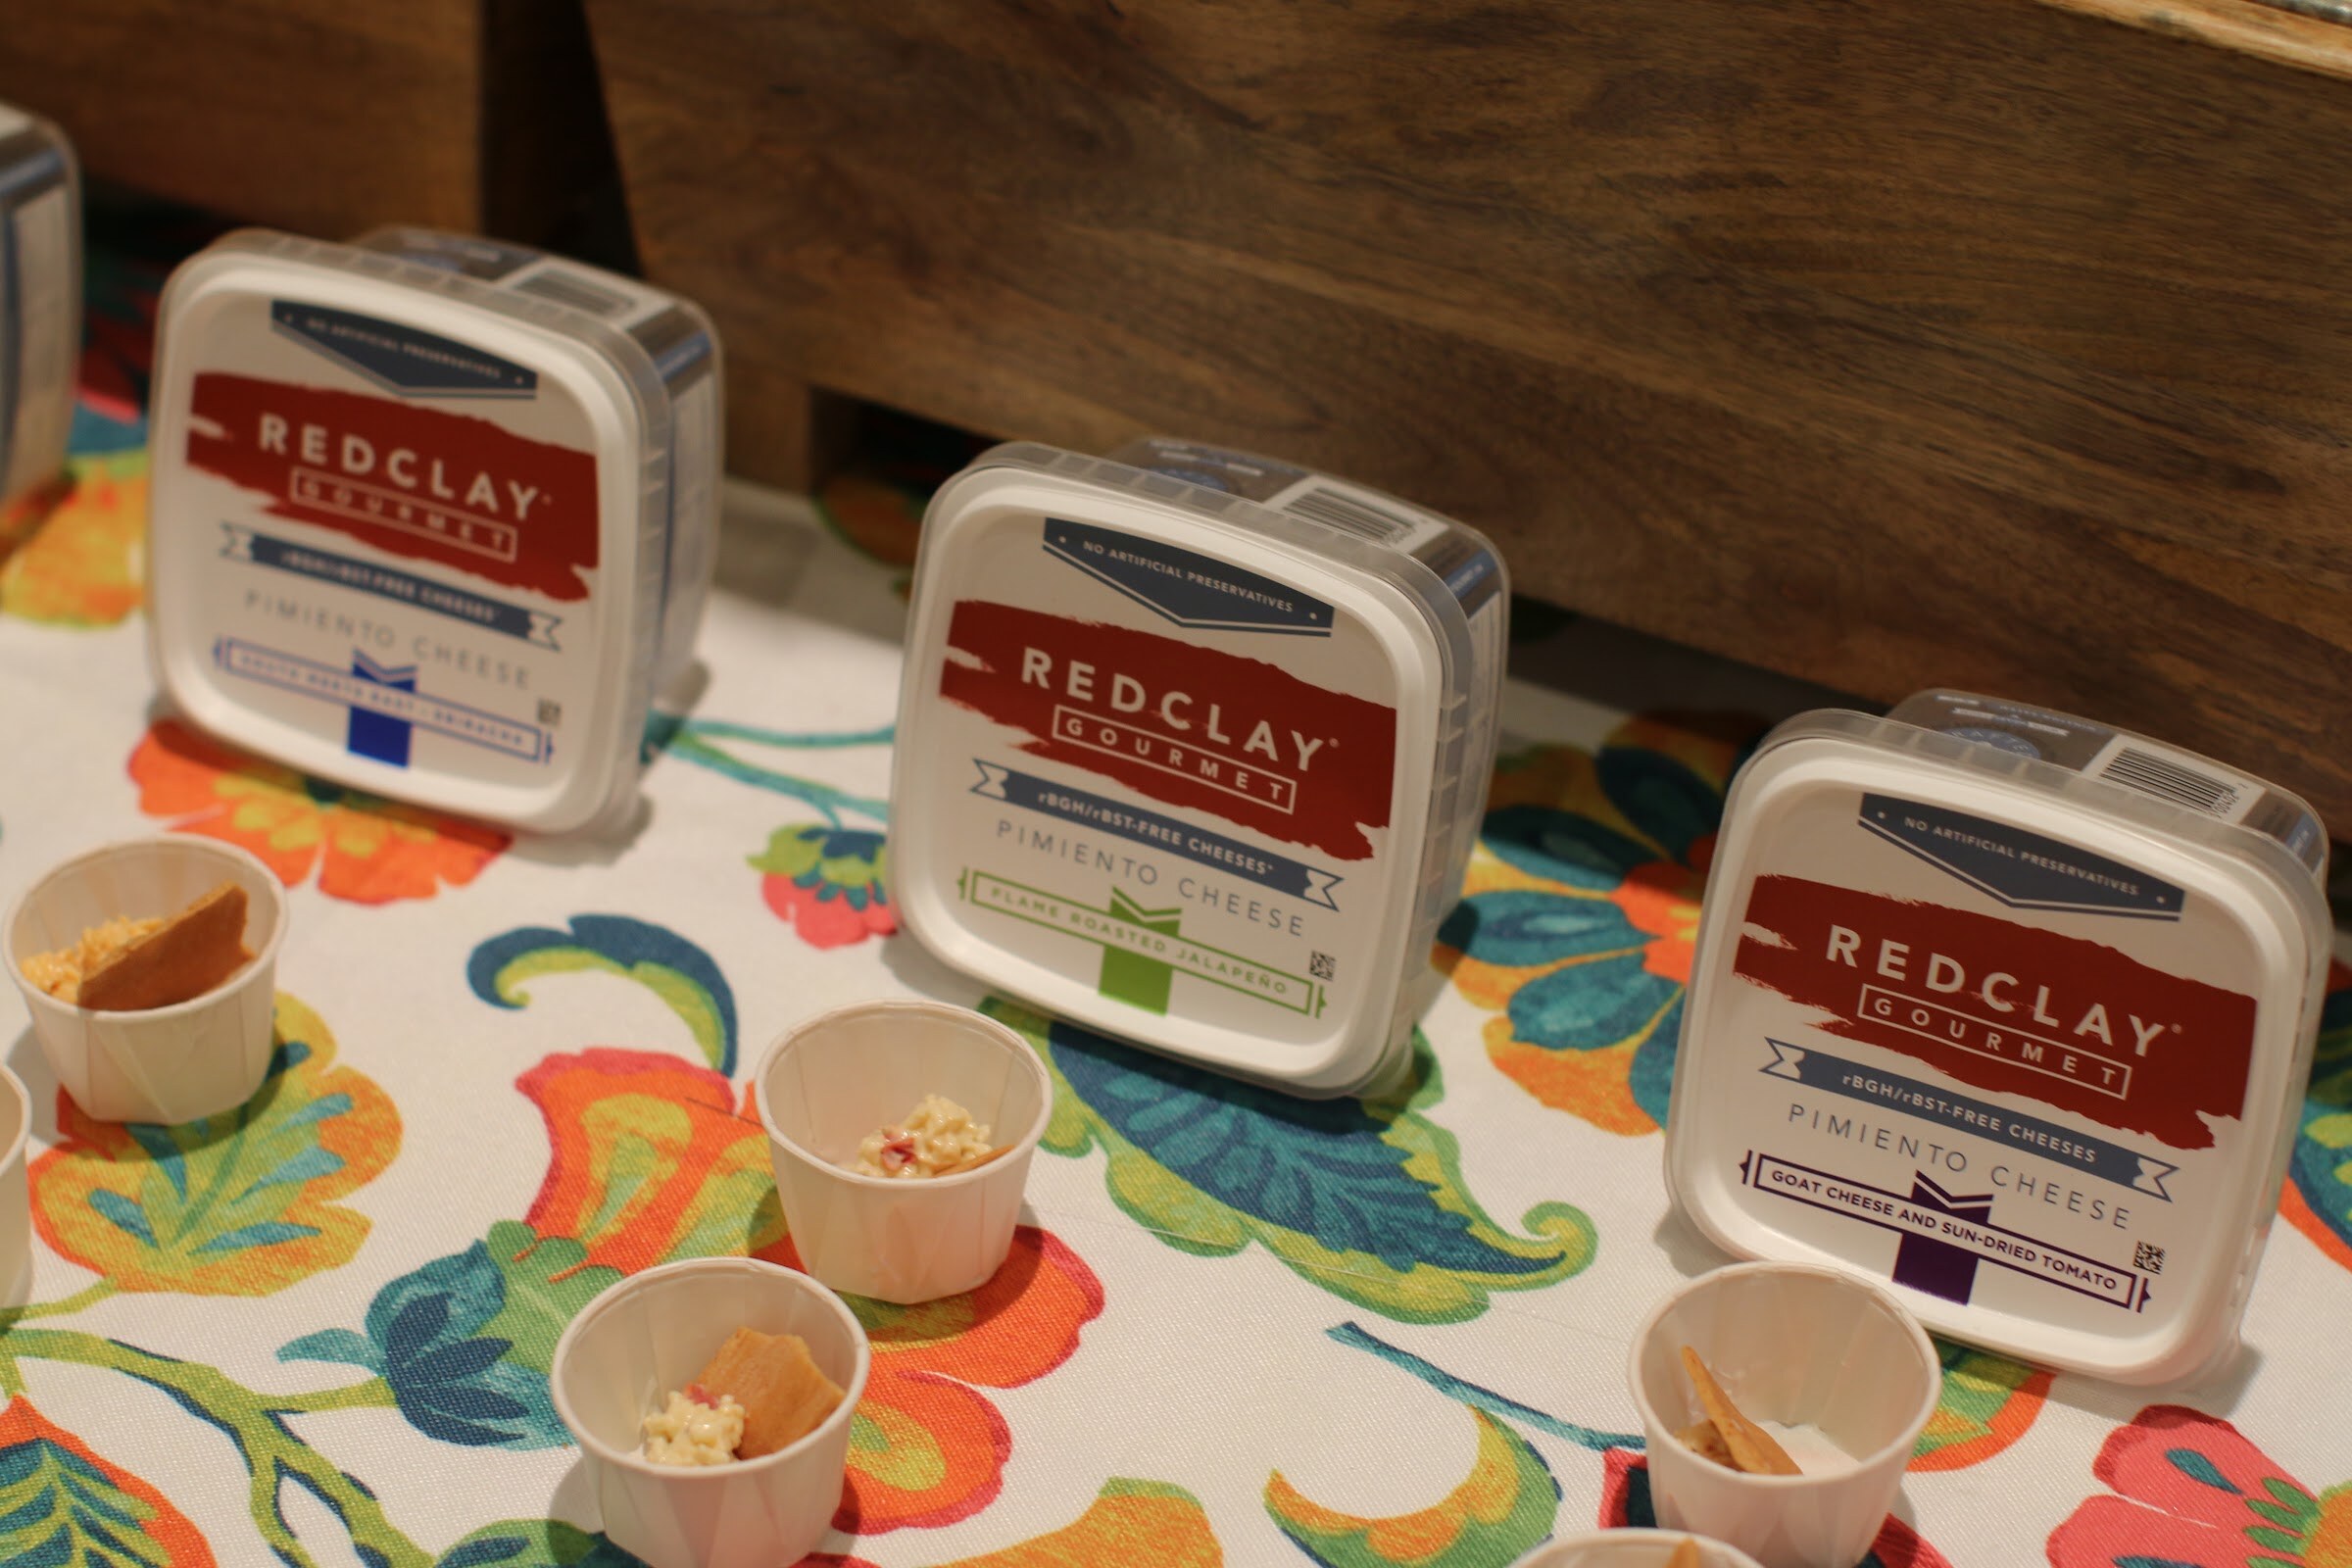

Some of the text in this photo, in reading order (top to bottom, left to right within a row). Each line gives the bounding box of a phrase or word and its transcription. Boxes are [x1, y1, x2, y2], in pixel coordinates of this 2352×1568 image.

[259, 412, 538, 520] REDCLAY
[1082, 539, 1294, 612] NO ARTIFICIAL PRESERVATIVES
[245, 589, 530, 690] PIMIENTO CHEESE
[1066, 717, 1283, 801] GOURMET
[997, 818, 1304, 937] PIMIENTO CHEESE
[1903, 815, 2141, 897] NO ARTIFICIAL PRESERVATIVES
[991, 886, 1060, 918] FLAME
[1069, 911, 1168, 954] ROASTED
[1873, 997, 2117, 1085] GOURMET
[1841, 1074, 2098, 1164] rBGH/rBST-FREE CHEESES
[1787, 1102, 2132, 1231] PIMIENTO CHEESE
[1771, 1169, 2118, 1292] GOAT CHEESE AND SUN-DRIED TOMATO
